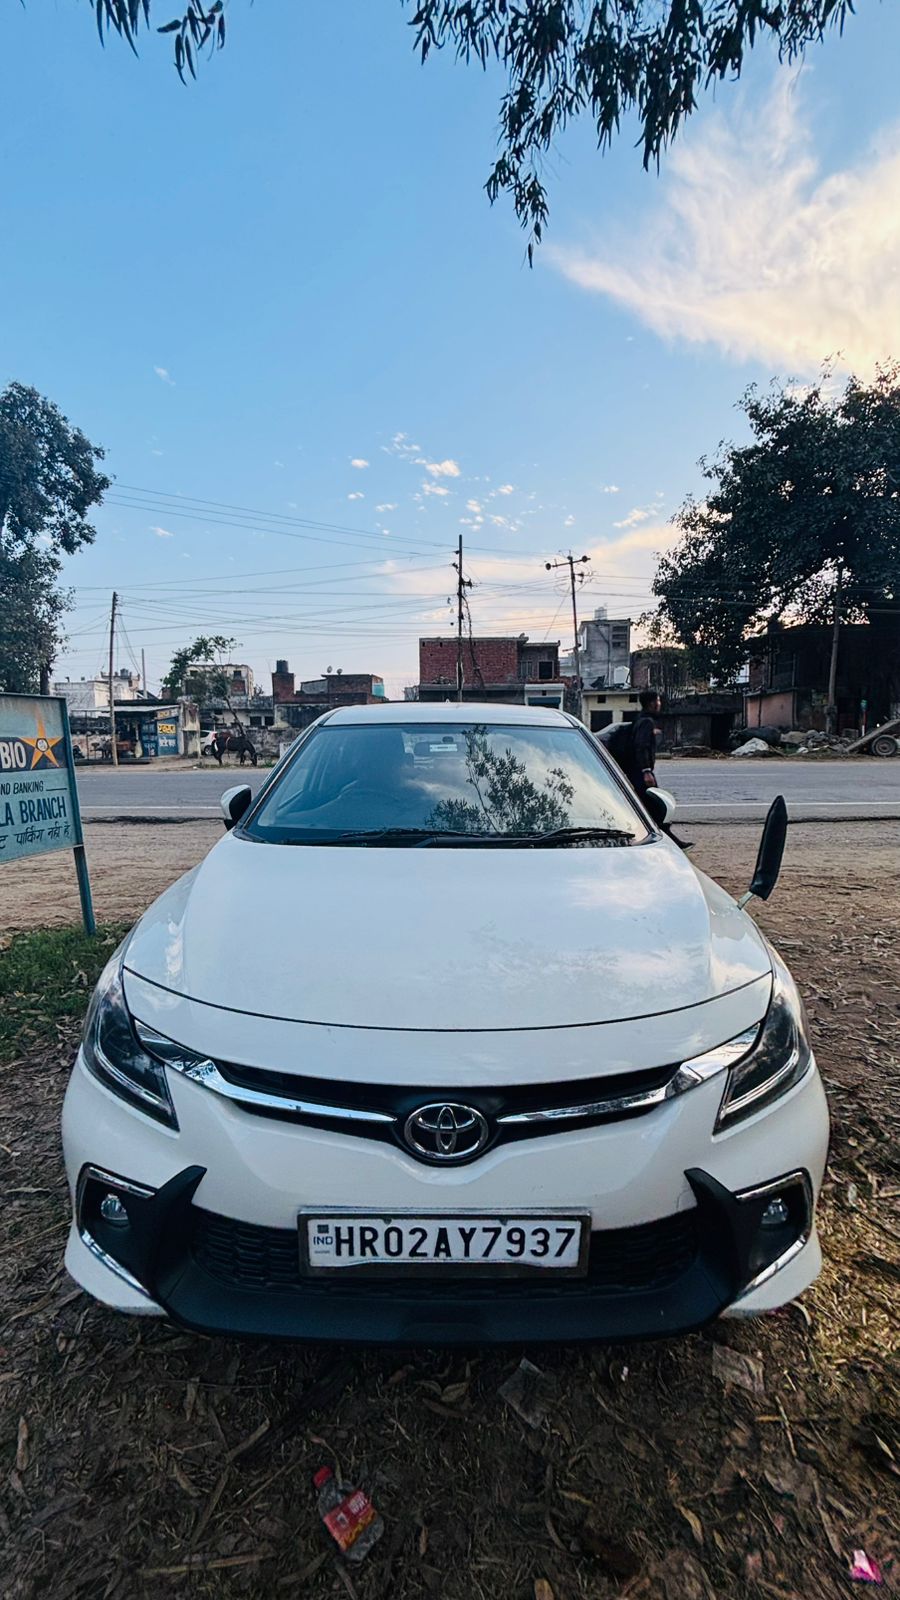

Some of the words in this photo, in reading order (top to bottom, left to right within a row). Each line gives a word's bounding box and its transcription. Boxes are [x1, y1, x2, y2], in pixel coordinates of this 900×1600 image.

[13, 780, 44, 795] BANKING
[19, 796, 67, 824] BRANCH
[313, 1236, 333, 1245] IND
[334, 1226, 576, 1258] HR02AY7937
